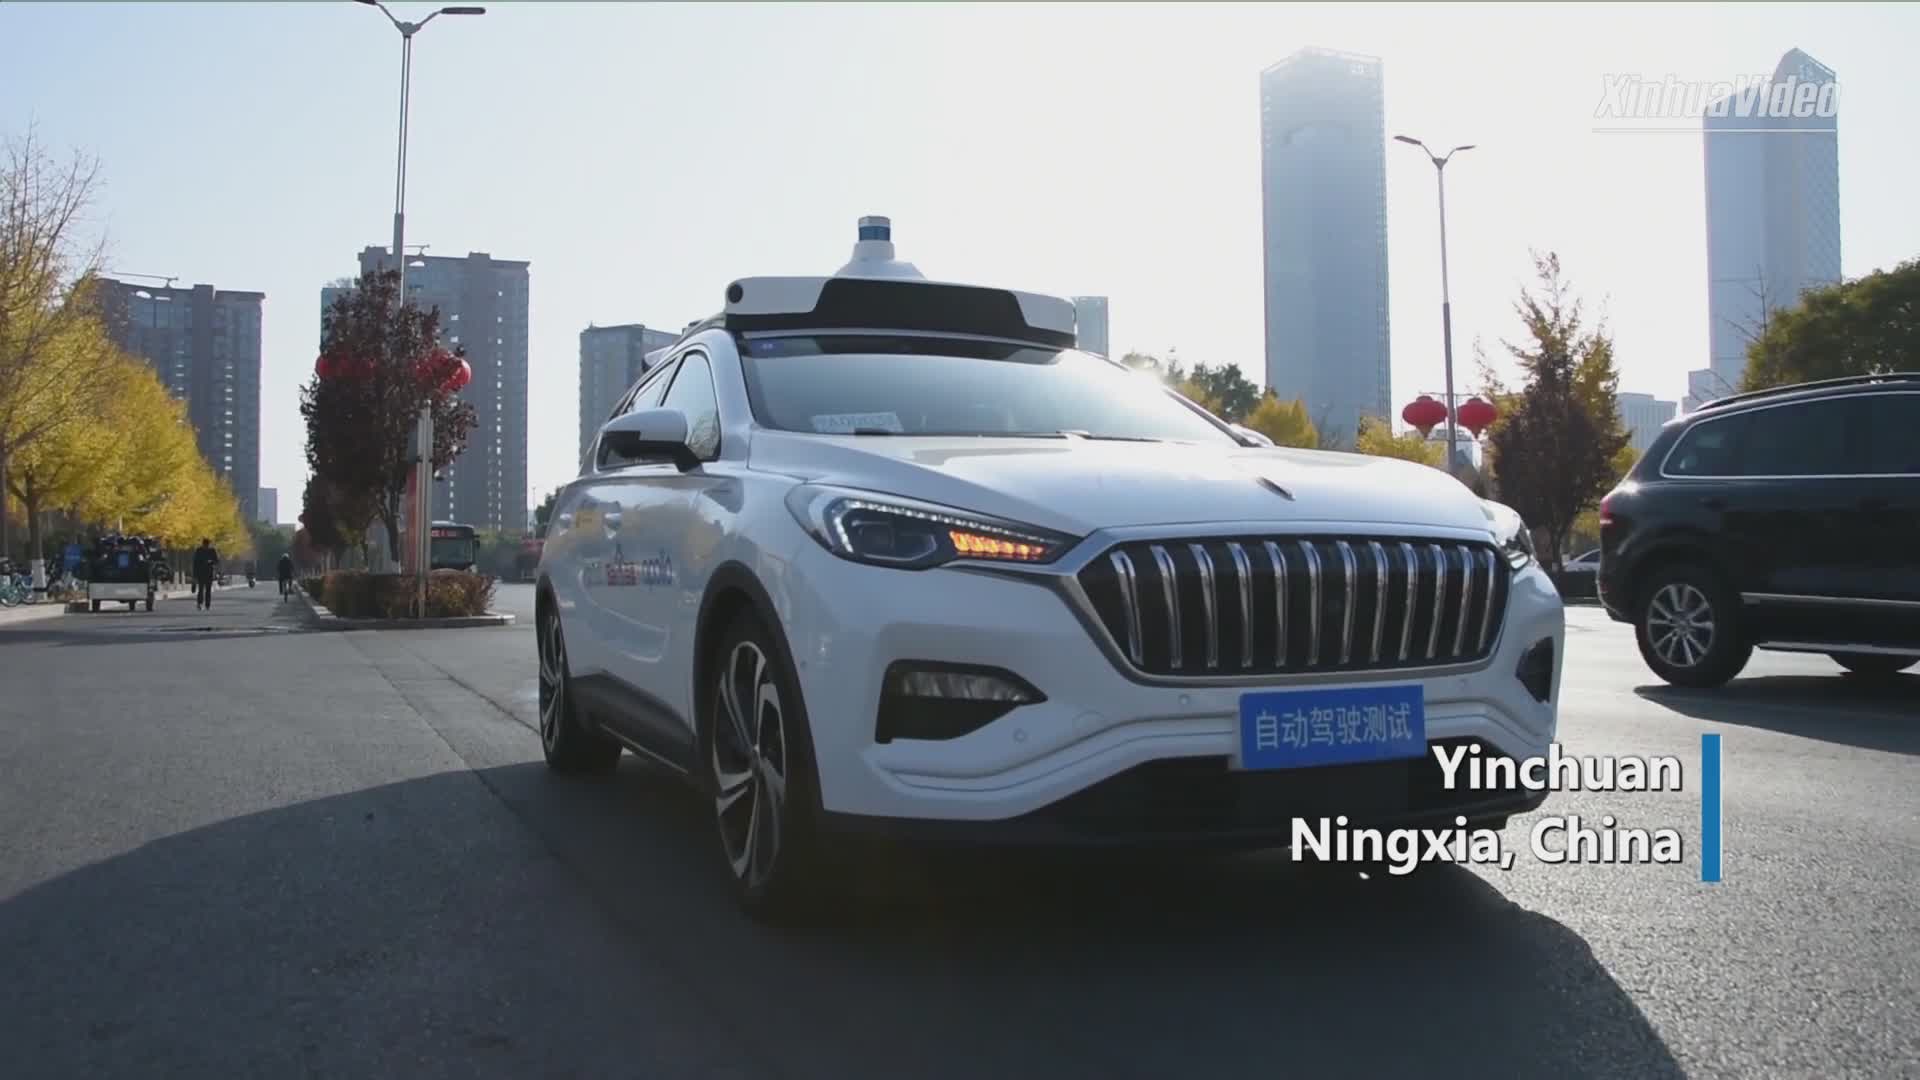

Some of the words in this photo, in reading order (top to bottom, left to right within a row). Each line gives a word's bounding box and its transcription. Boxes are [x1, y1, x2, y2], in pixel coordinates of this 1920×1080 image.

[1254, 702, 1414, 752] 自动驾驶测试
